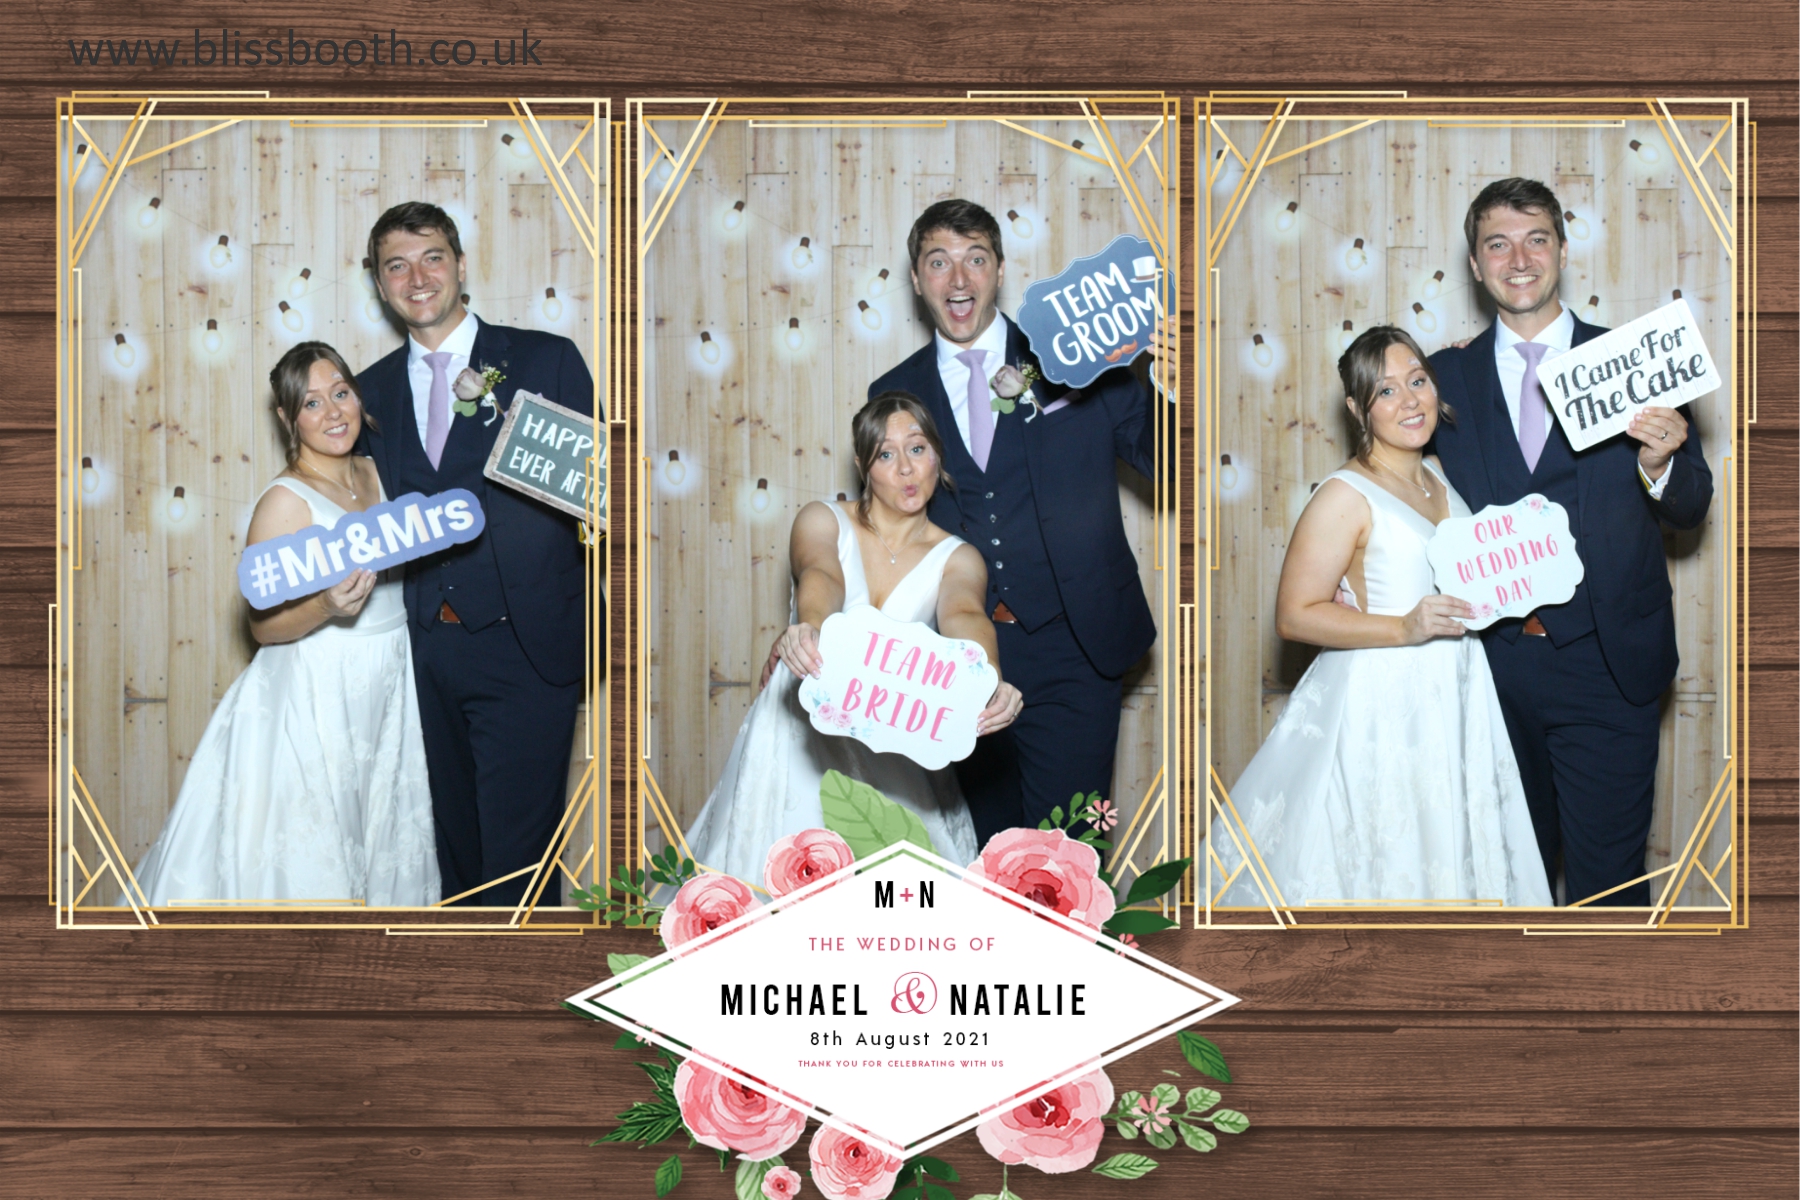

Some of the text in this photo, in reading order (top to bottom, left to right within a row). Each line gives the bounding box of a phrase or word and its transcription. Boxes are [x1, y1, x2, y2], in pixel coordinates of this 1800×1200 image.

[1042, 262, 1131, 327] TEAM
[1052, 287, 1164, 366] GROOM
[1554, 326, 1686, 399] I Came For
[1565, 353, 1707, 431] The Cake
[508, 446, 556, 485] EVER
[250, 499, 475, 598] #Mr&Mrs
[1456, 533, 1558, 584] WEDDING
[1474, 514, 1517, 544] OUR
[1495, 575, 1533, 607] DAY
[863, 631, 957, 690] TEAM
[842, 677, 954, 742] BRIDE
